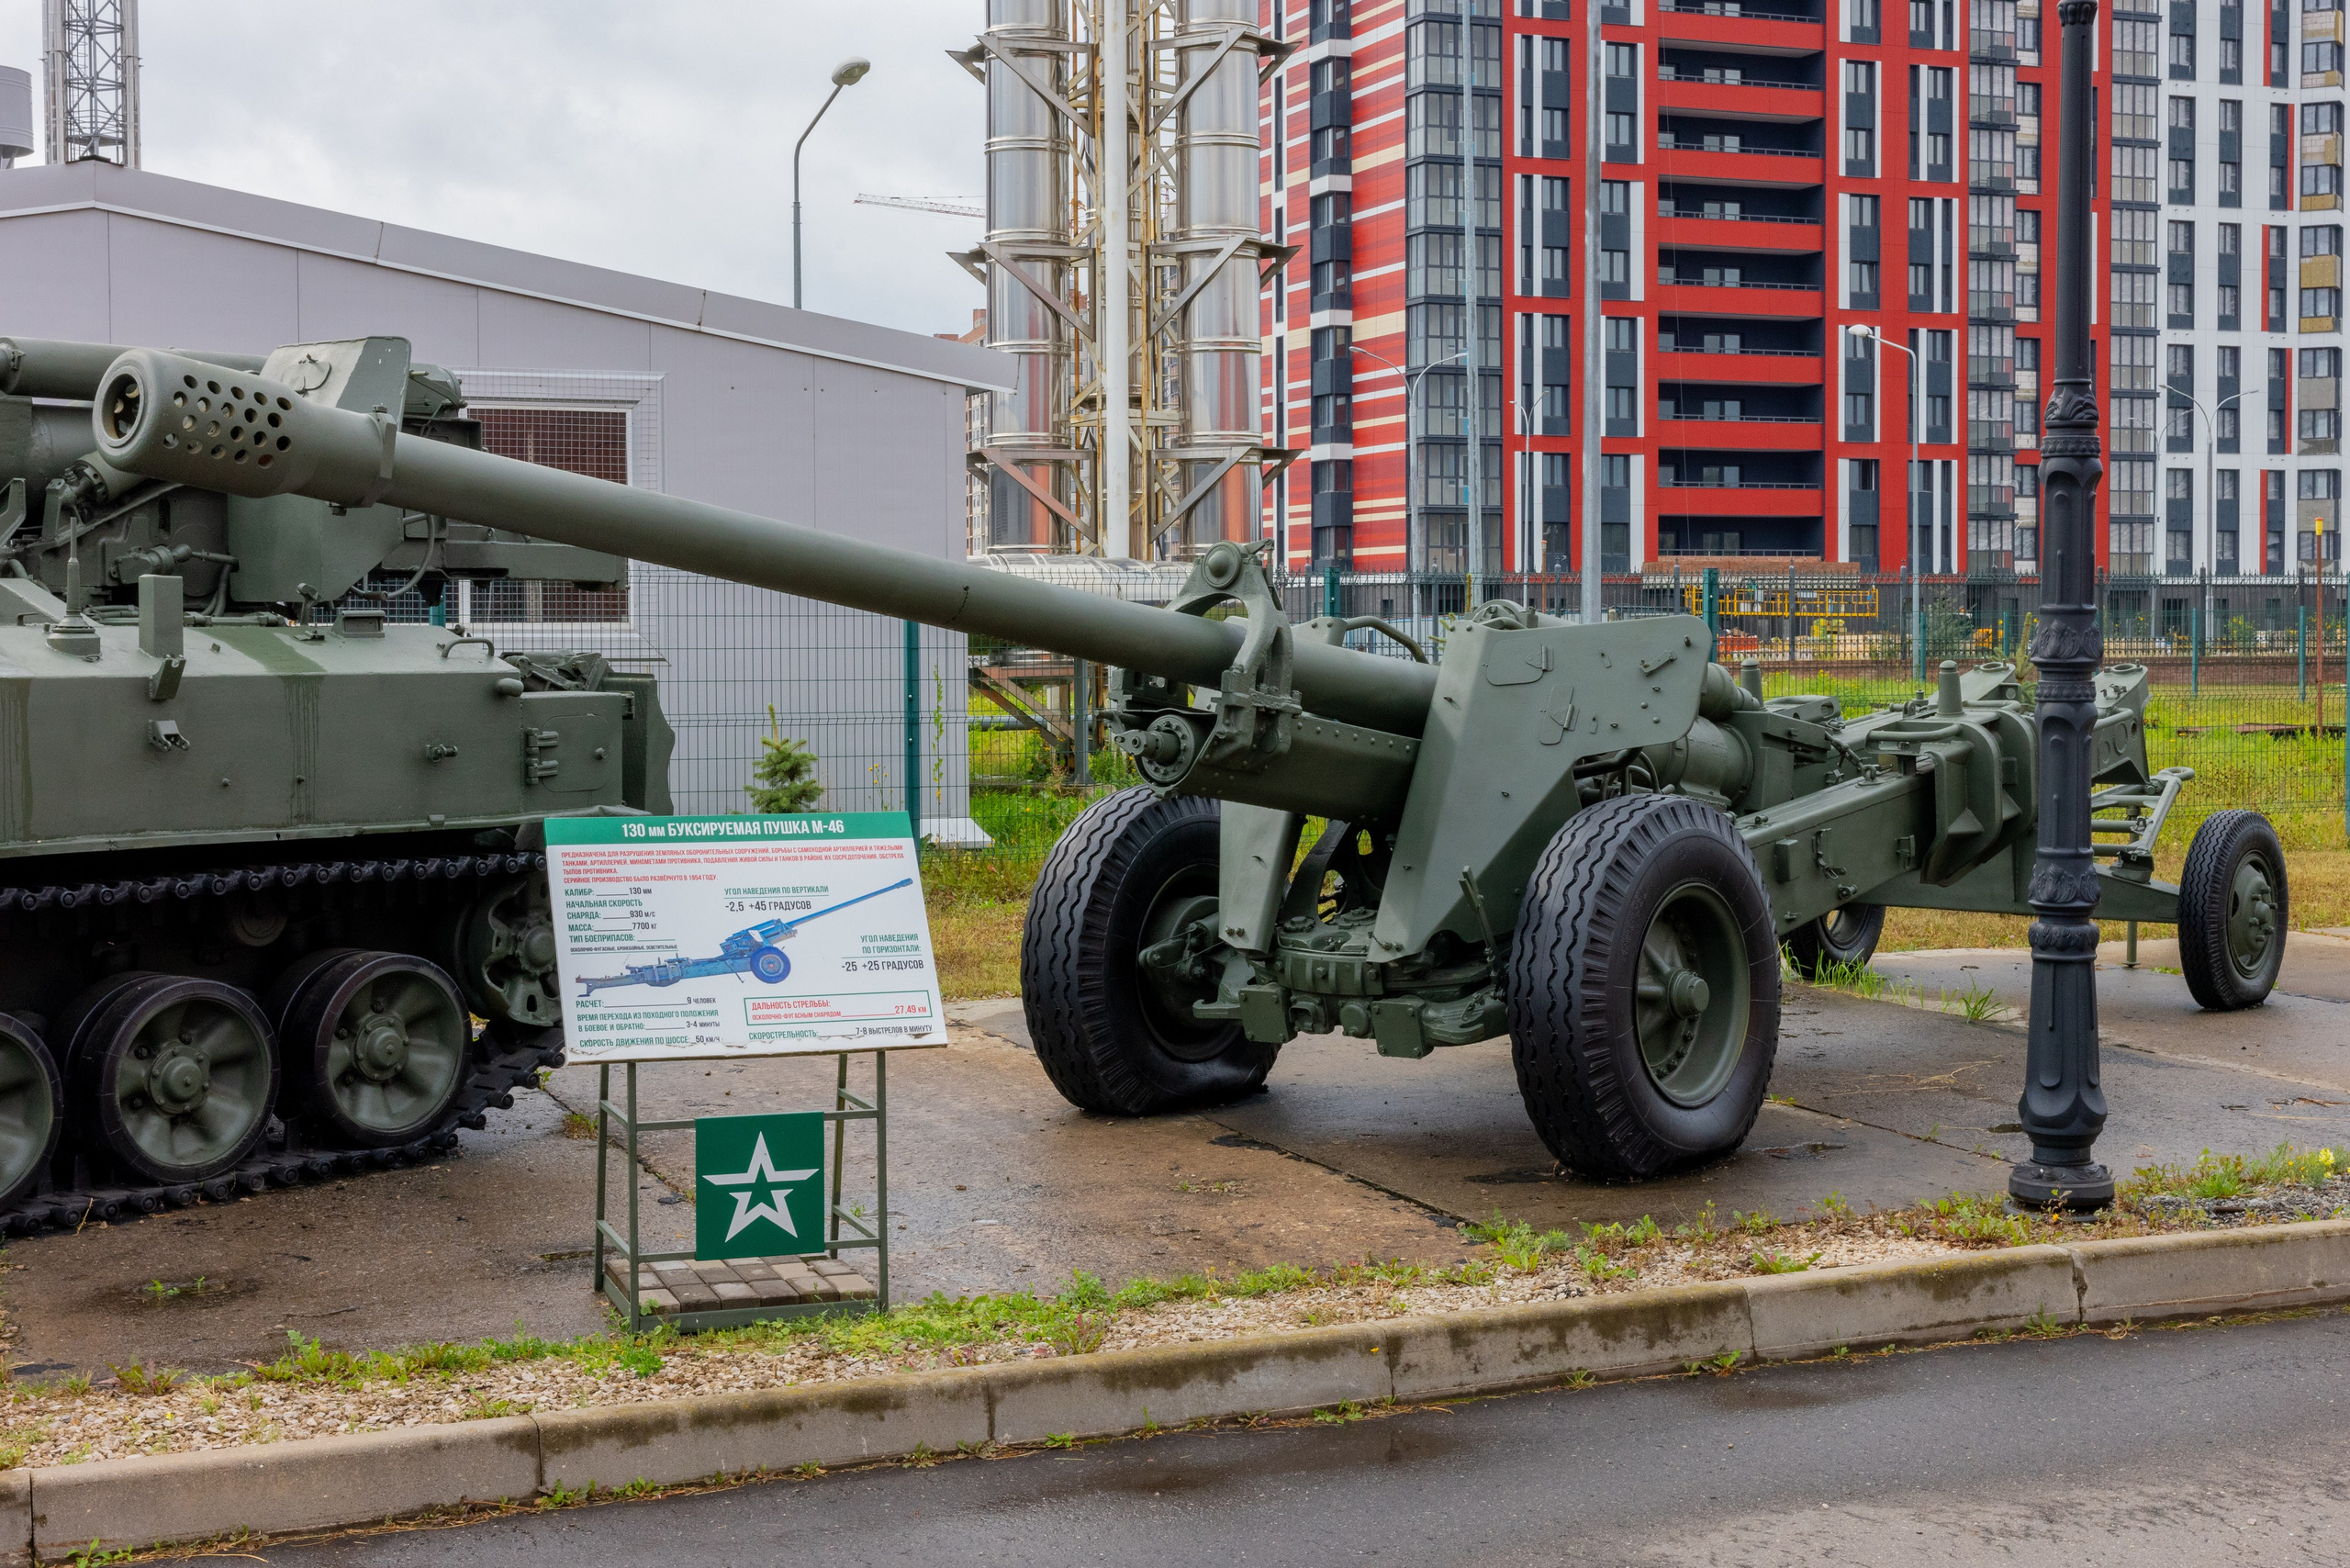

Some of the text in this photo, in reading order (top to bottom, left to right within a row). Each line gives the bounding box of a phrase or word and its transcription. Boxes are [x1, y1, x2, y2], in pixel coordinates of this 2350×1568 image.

[621, 823, 645, 837] 130
[667, 821, 761, 836] БУКСИРУЕМАЯ
[763, 820, 810, 834] ПУШКА
[811, 819, 845, 834] М-46
[560, 850, 607, 858] ПРЕДНАЗНАЧЕНА
[619, 849, 655, 857] РАЗРУШЕНИЯ
[563, 876, 591, 884] СЕРИЙНОЕ
[591, 875, 632, 883] ПРОИЗВОДСТВО
[564, 888, 594, 896] КАЛИБР:
[742, 886, 781, 895] НАВЕДЕНИЯ
[791, 885, 829, 893] ВЕРТИКАЛИ
[565, 899, 643, 908] НАЧАЛЬНАЯ СКОРОСТЬ
[724, 900, 811, 913] -2,5 +45 ГРАДУСОВ
[566, 911, 600, 920] СНАРЯДА:
[567, 923, 594, 932] МАССА:
[568, 933, 635, 943] ТИП БОЕПРИПАСОВ:
[859, 933, 919, 943] УГОЛ НАВЕДЕНИЯ
[861, 944, 921, 954] ПО ГОРИЗОНТАЛИ:
[841, 959, 924, 971] -25 +25 ГРАДУСОВ
[575, 999, 604, 1008] РАСЧЕТ:
[751, 999, 831, 1011] ДАЛЬНОСТЬ СТРЕЛЬБЫ:
[576, 1013, 599, 1022] ВРЕМЯ
[599, 1012, 632, 1021] ПЕРЕХОДА
[642, 1010, 679, 1020] ПОХОДНОГО
[679, 1009, 719, 1017] ПОЛОЖЕНИЯ
[751, 1012, 813, 1021] ОСКОЛОЧНО-ФУГАСНЫМ
[813, 1010, 841, 1018] СНАРЯДОМ
[584, 1023, 608, 1032] БОЕВОЕ
[615, 1022, 645, 1031] ОБРАТНО:
[686, 1020, 698, 1028] 3-4
[748, 1028, 819, 1040] СКОРОСТРЕЛЬНОСТЬ:
[867, 1025, 903, 1035] ВЫСТРЕЛОВ
[579, 1037, 614, 1047] СКОРОСТЬ
[614, 1036, 654, 1047] ДВИЖЕНИЯ
[655, 1036, 665, 1045] ПО
[665, 1035, 690, 1044] ШОССЕ:
